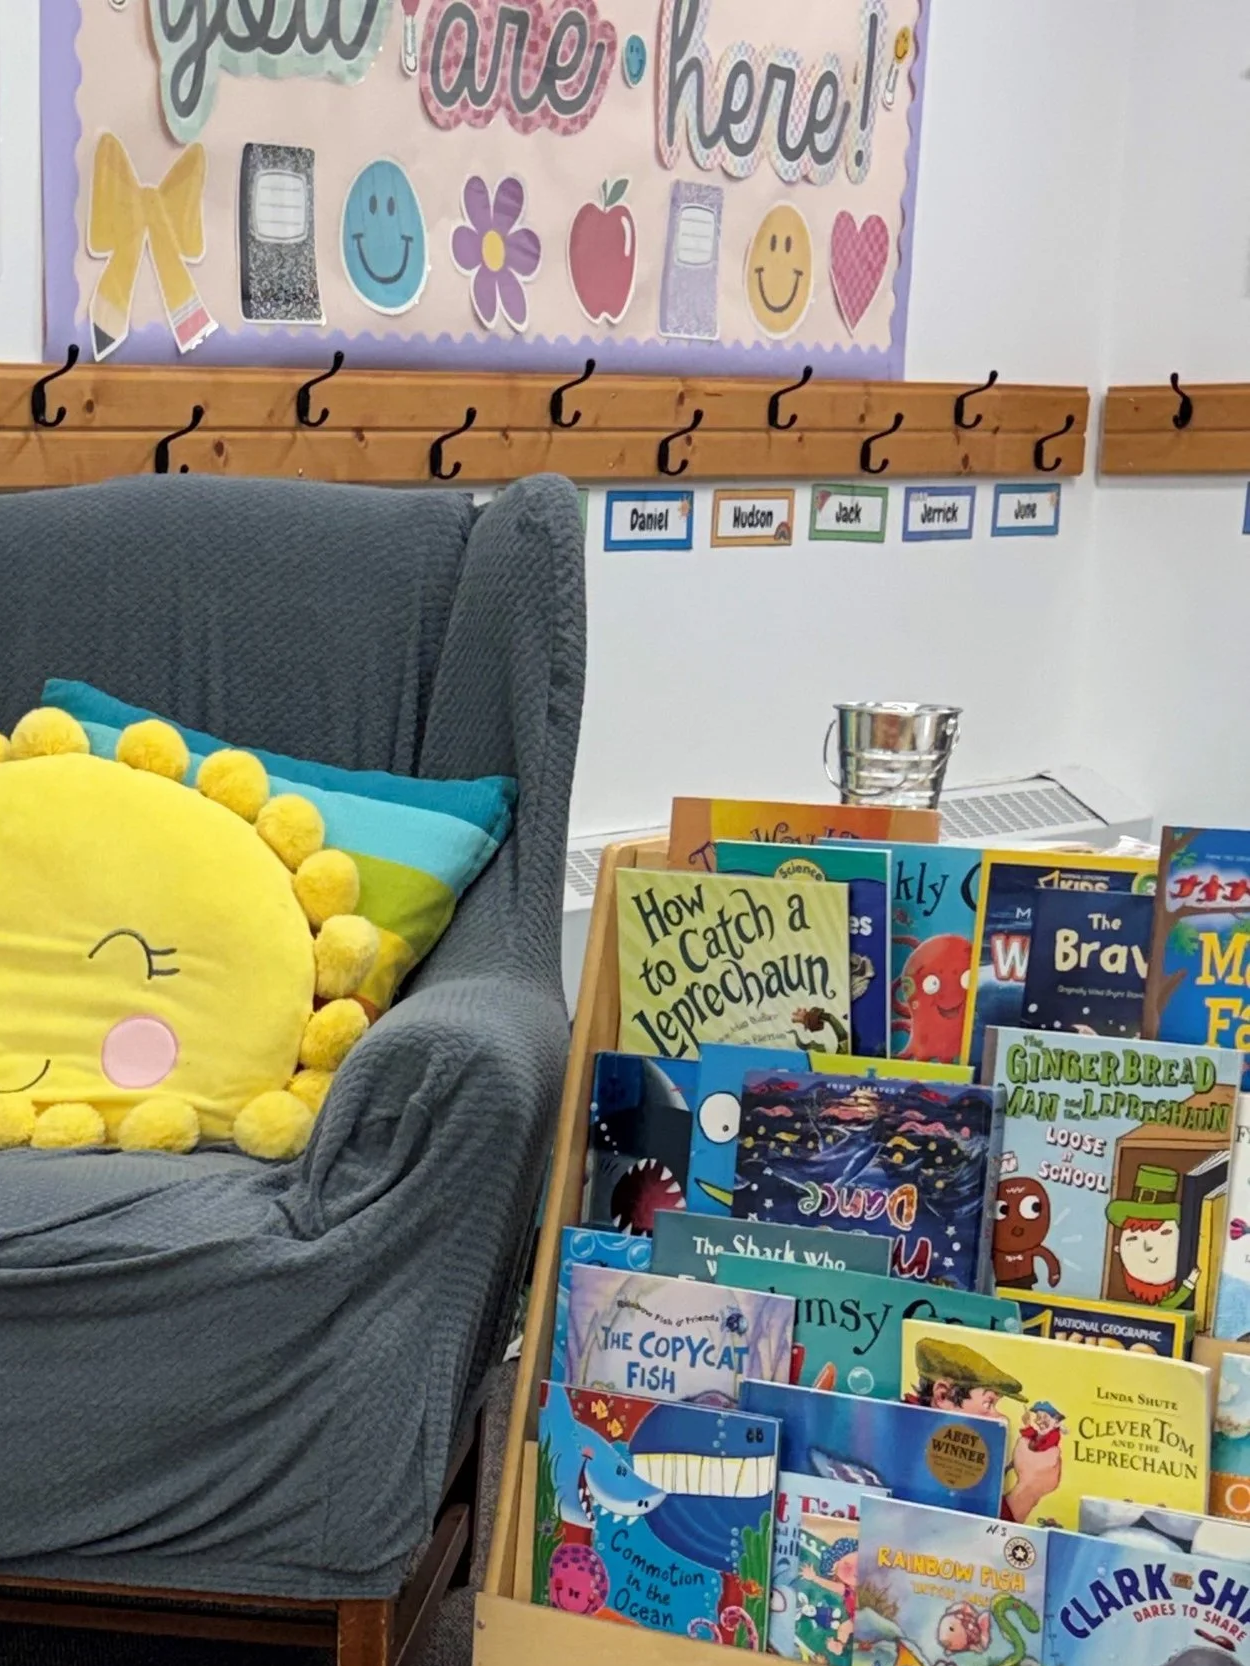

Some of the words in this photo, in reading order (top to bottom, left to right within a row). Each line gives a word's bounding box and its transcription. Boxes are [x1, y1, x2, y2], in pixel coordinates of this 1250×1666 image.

[433, 3, 605, 115] are
[664, 0, 877, 168] here!
[630, 506, 670, 532] Daniel
[732, 505, 774, 530] Hudson
[835, 501, 862, 526] Jack
[920, 501, 960, 526] Jerrick
[1013, 500, 1038, 520] June
[778, 862, 824, 880] Science
[631, 884, 706, 947] How
[1087, 912, 1123, 931] The
[639, 957, 677, 996] to
[679, 888, 775, 973] Catch
[788, 893, 810, 933] a
[1054, 928, 1149, 979] Brav
[1004, 1085, 1061, 1121] MAN
[1082, 1088, 1233, 1133] LEPRECHAUN
[1046, 1126, 1107, 1157] LOOSE
[1037, 1160, 1109, 1193] SCHOOL
[692, 1235, 725, 1256] The
[732, 1234, 796, 1263] Shark
[803, 1250, 847, 1272] Who
[654, 1312, 673, 1326] Fish
[1053, 1316, 1100, 1333] NATIONAL
[1101, 1323, 1162, 1342] GEOGRAPHIC
[601, 1326, 633, 1351] THE
[638, 1331, 751, 1374] COPYCAT
[626, 1361, 676, 1394] FISH
[1096, 1386, 1134, 1405] LINDA
[1137, 1393, 1179, 1411] SHUTE
[1078, 1415, 1152, 1440] CLEVER
[932, 1437, 986, 1465] WINNER
[1073, 1440, 1198, 1481] LEPRECHAUN
[1110, 1439, 1136, 1451] AND
[1137, 1442, 1161, 1455] THE
[609, 1528, 706, 1588] Commotion
[877, 1545, 975, 1584] RAINBOW
[980, 1564, 1027, 1594] FISH
[626, 1573, 641, 1593] in
[646, 1582, 671, 1607] the
[1059, 1563, 1173, 1640] CLARK
[613, 1588, 675, 1627] Ocean
[1132, 1602, 1177, 1623] DARES
[1182, 1603, 1199, 1619] TO
[1202, 1610, 1248, 1643] SHARE
